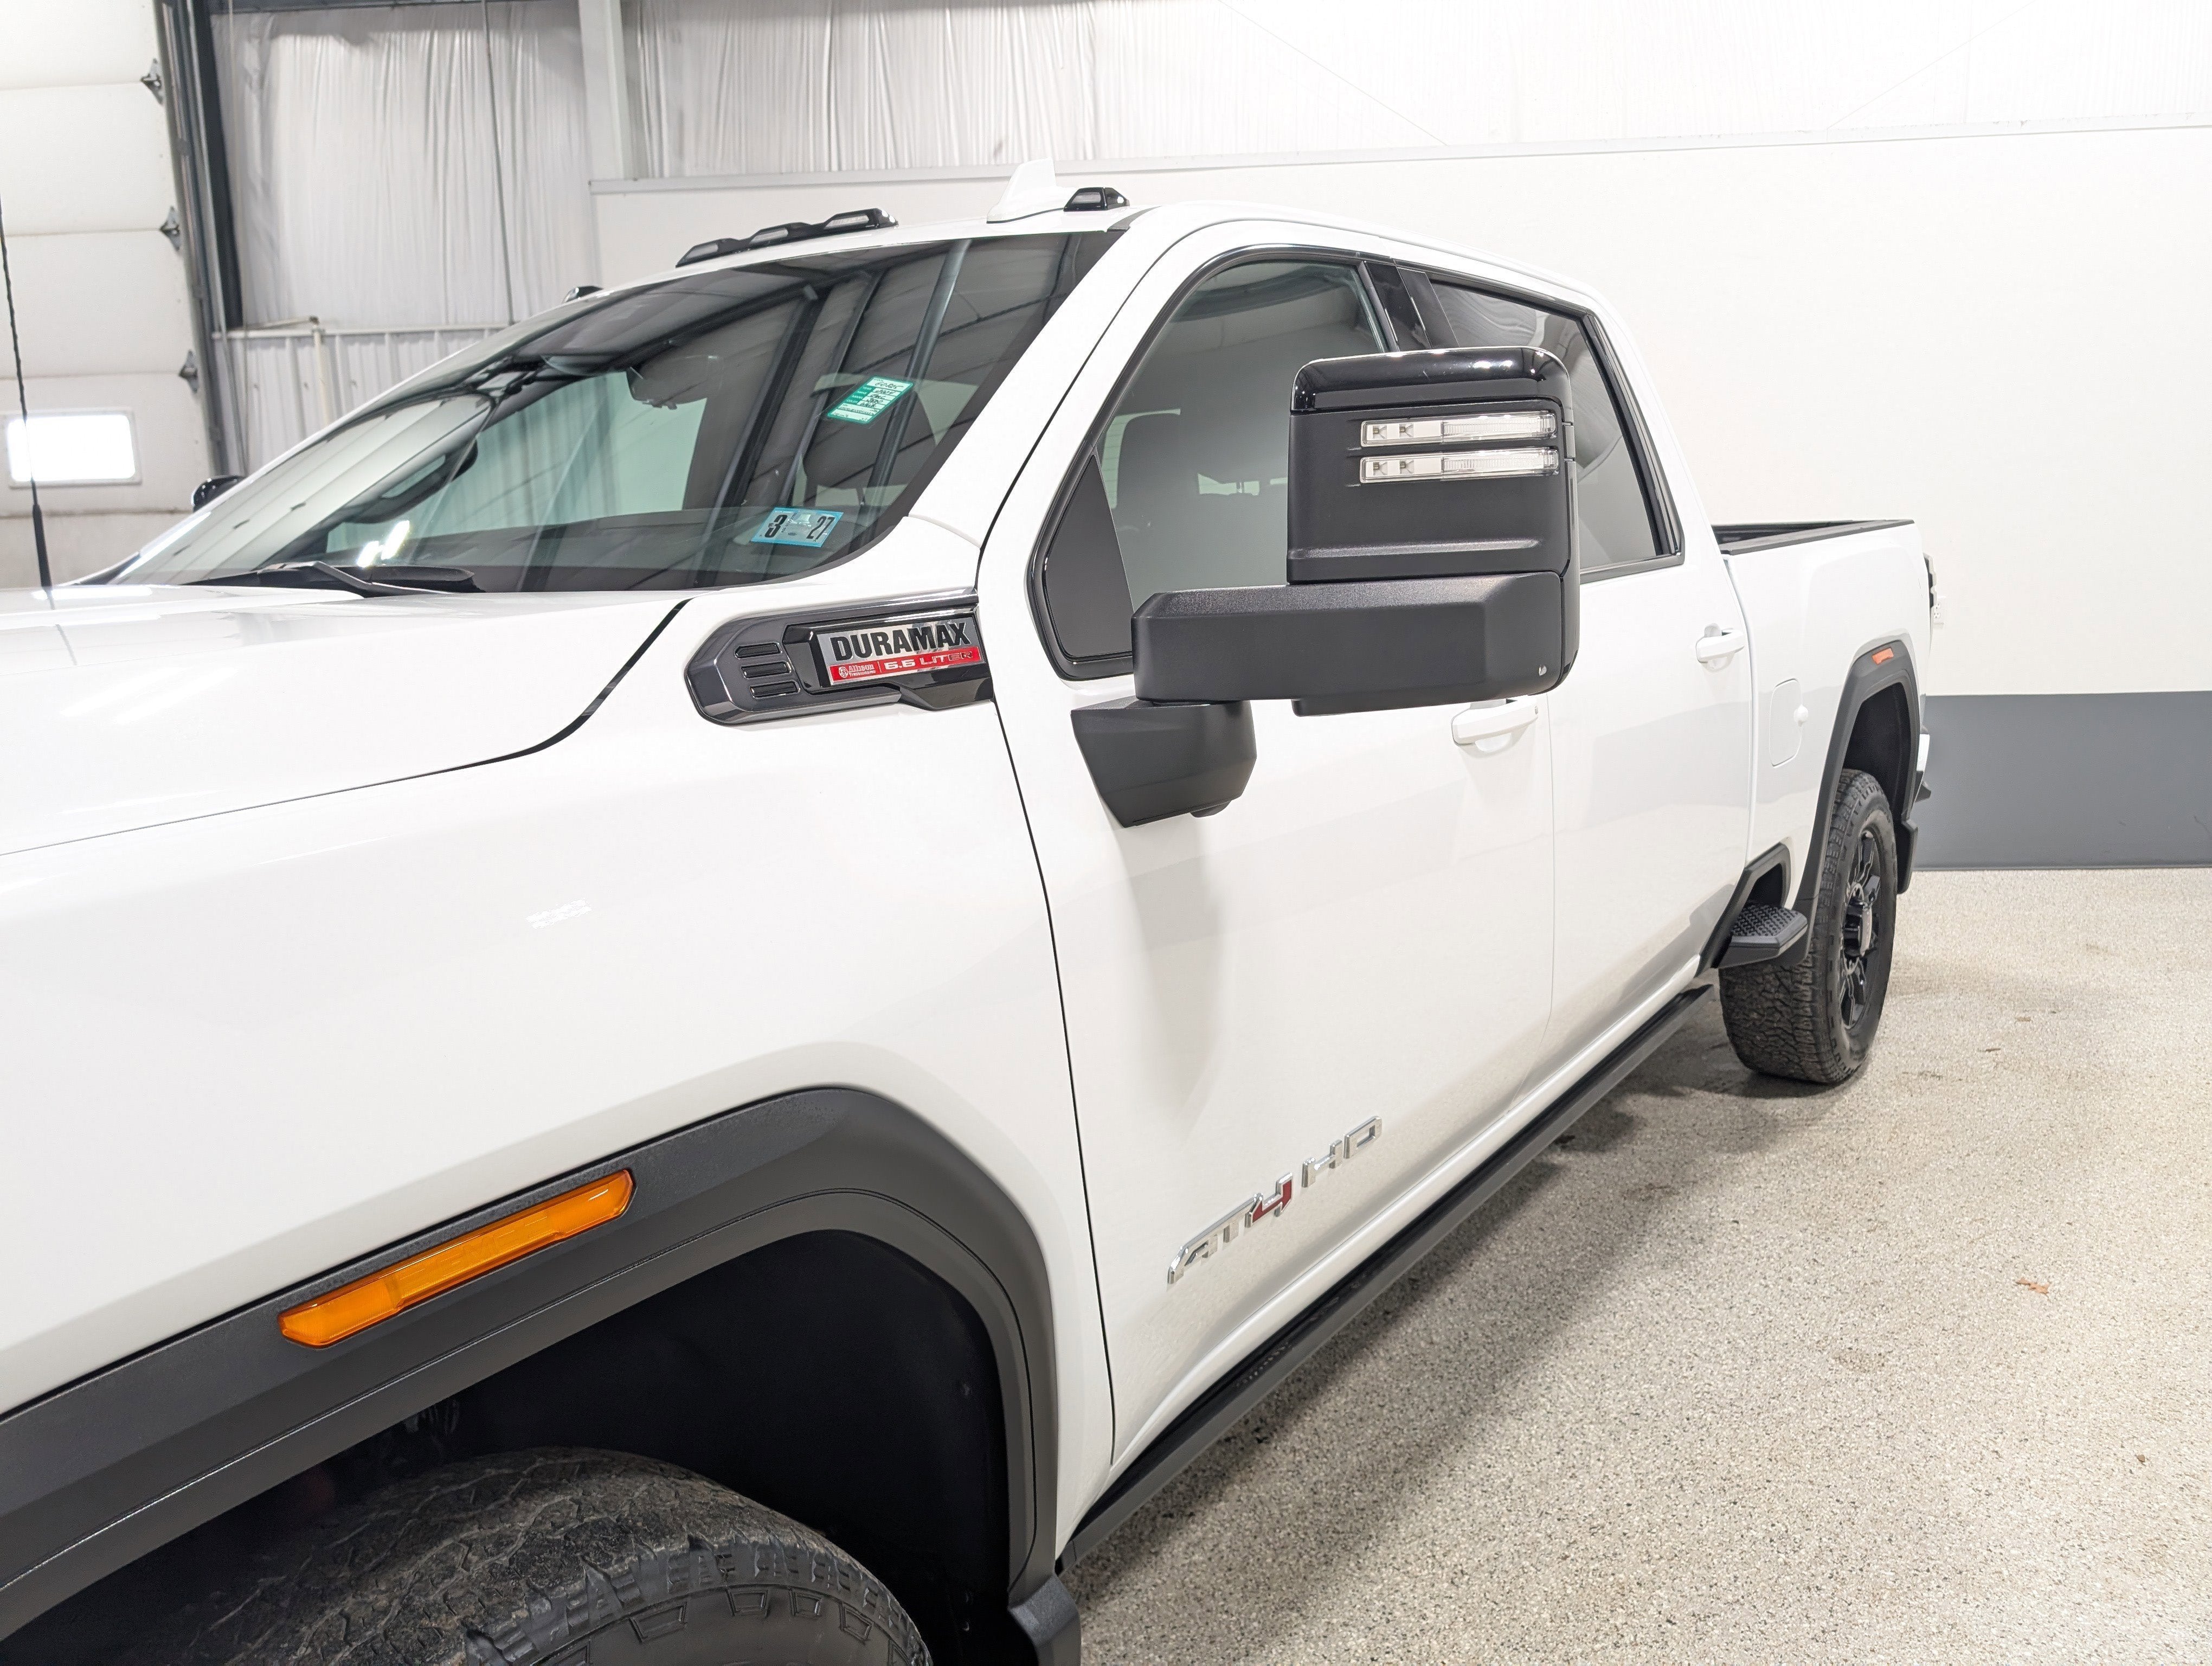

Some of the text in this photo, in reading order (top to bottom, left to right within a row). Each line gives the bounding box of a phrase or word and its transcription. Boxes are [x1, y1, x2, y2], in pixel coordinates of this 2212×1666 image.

[764, 515, 788, 538] 3
[806, 516, 835, 540] 27
[829, 622, 971, 662] DURAMAX
[884, 651, 974, 670] 6.6 LITER
[1167, 1116, 1382, 1284] AT4 HD
